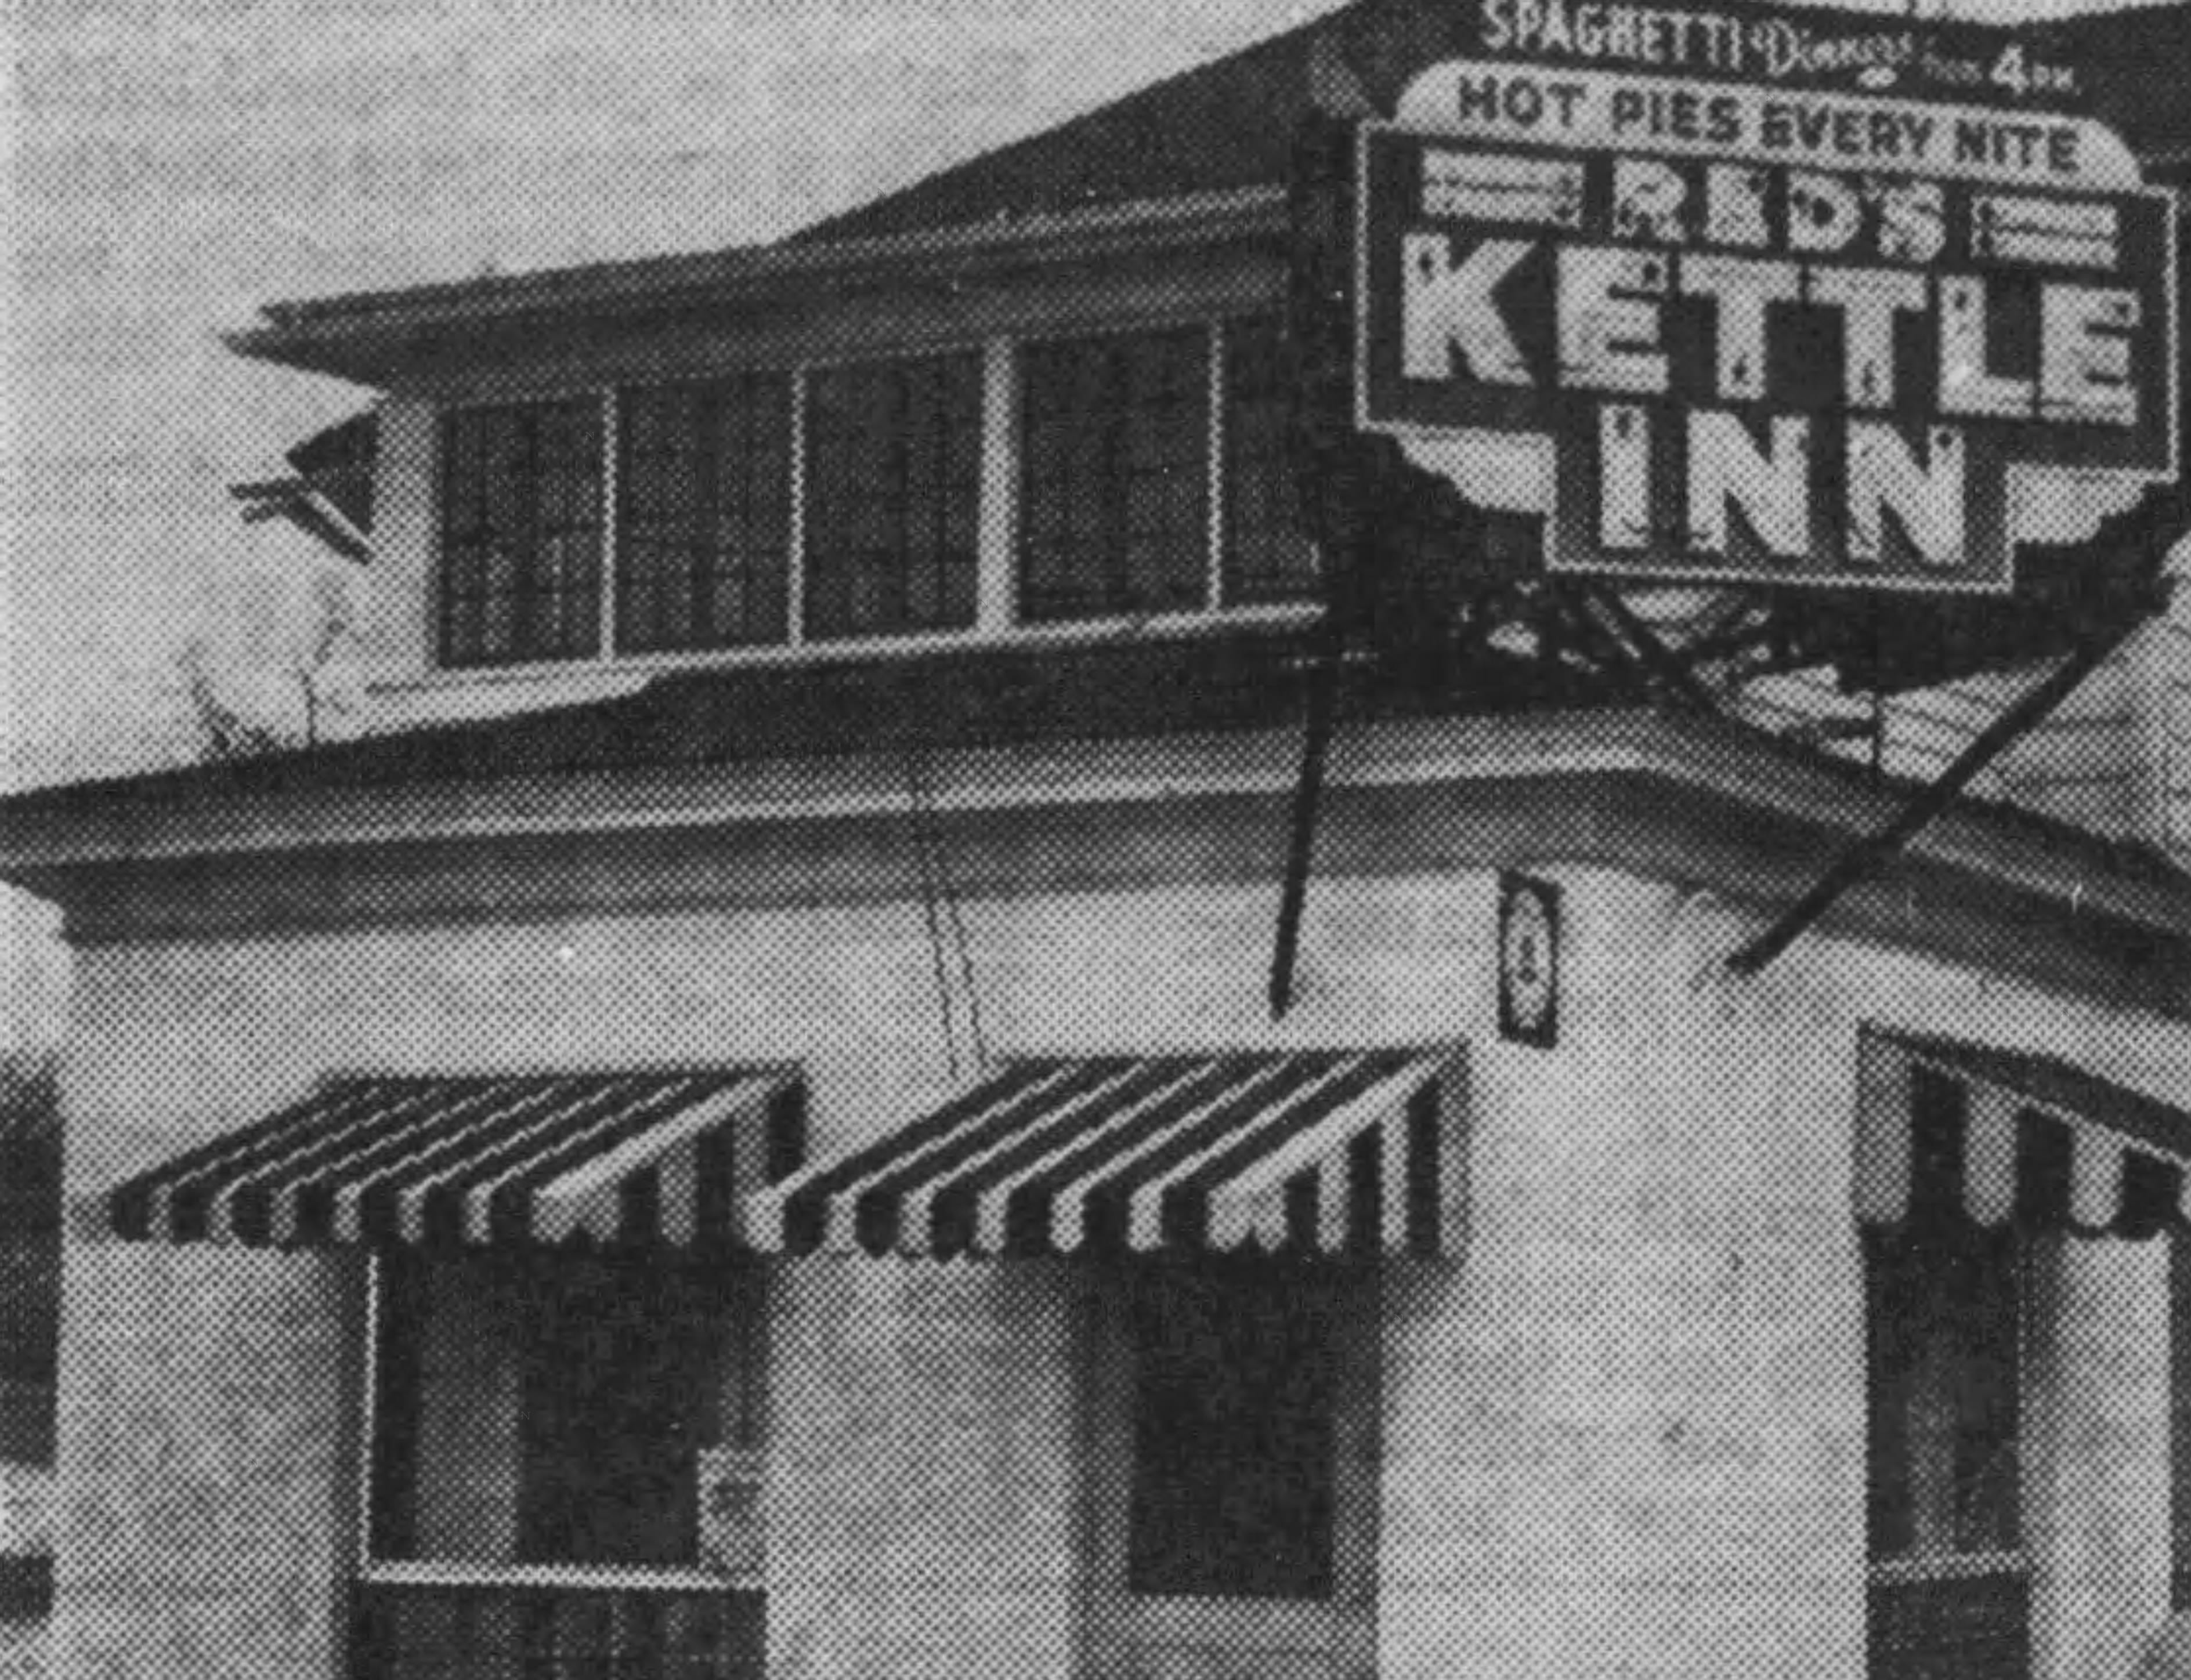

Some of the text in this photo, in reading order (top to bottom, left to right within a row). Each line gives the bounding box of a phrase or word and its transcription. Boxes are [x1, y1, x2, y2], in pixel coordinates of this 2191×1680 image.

[1481, 0, 1740, 70] SPAGHETTI
[1458, 74, 2081, 173] HOT PIES EVERY NITE
[1613, 159, 1946, 263] RED'S
[1402, 233, 2141, 425] KETTLE
[1600, 404, 1965, 563] INN
